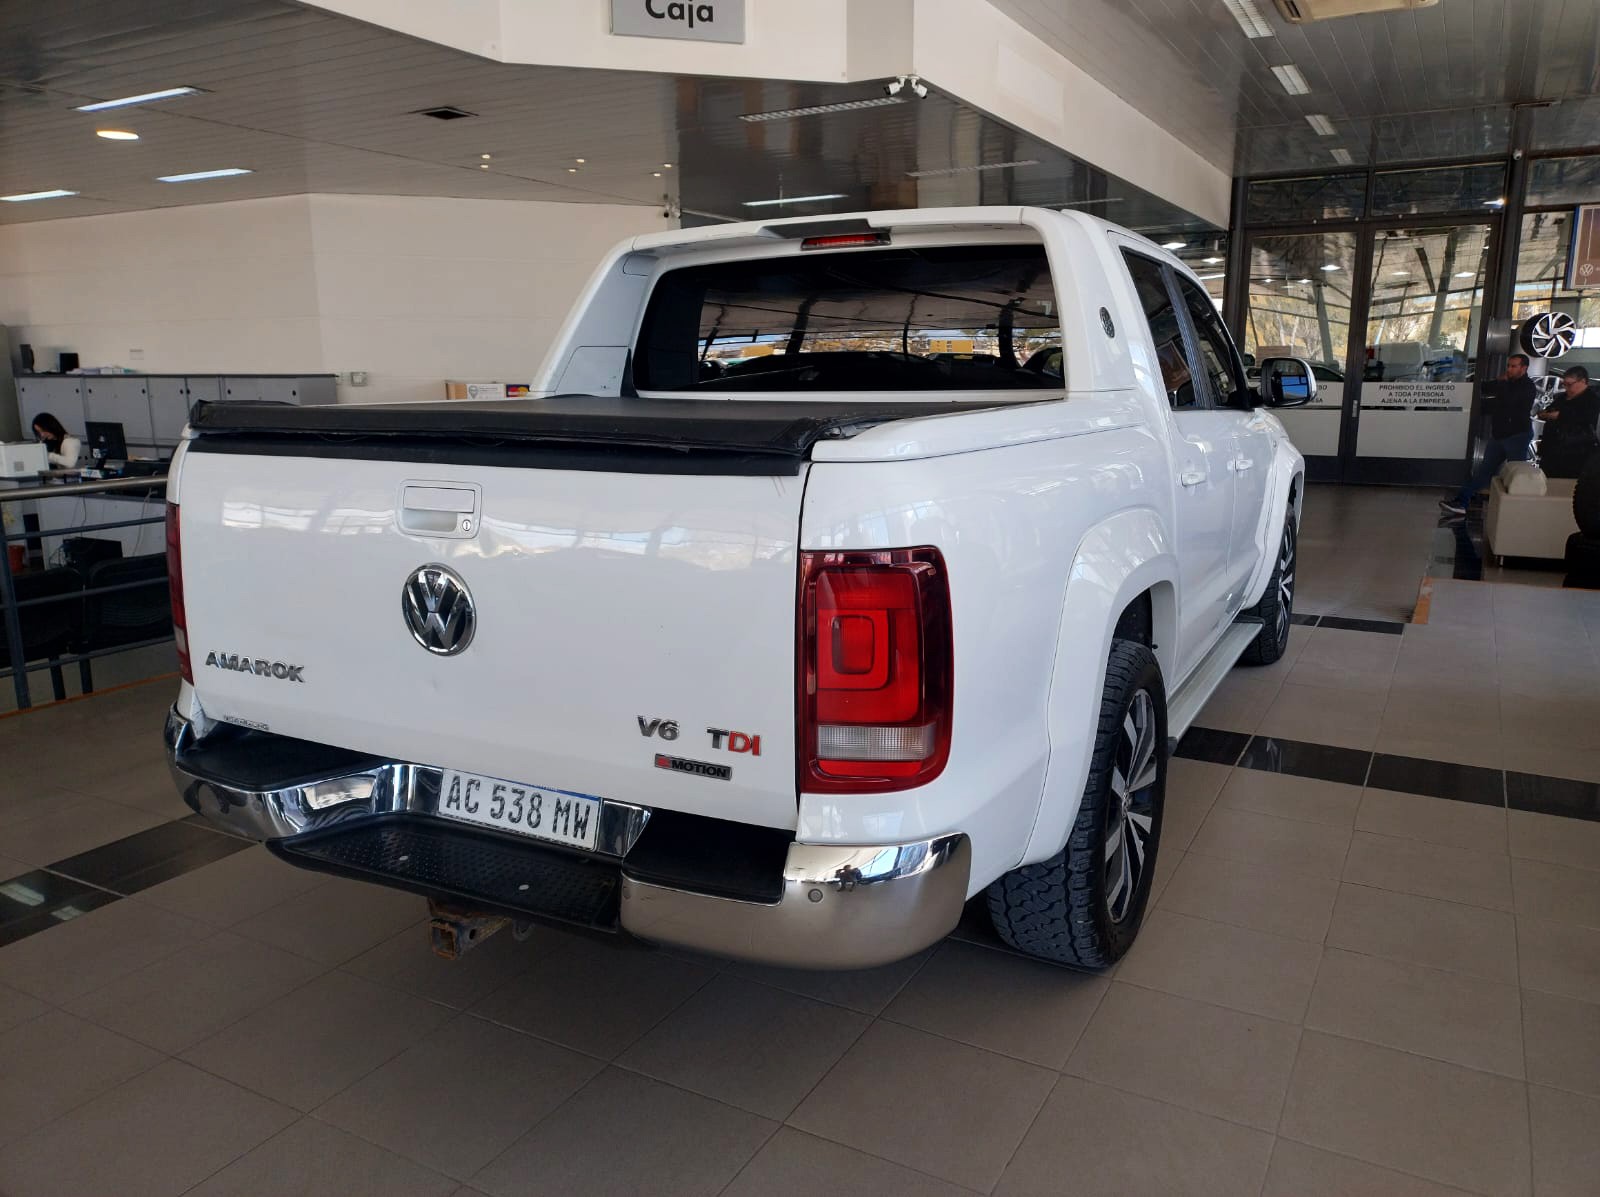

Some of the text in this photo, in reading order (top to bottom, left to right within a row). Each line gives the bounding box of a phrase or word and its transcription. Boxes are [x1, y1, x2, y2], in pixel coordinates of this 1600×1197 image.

[645, 0, 714, 28] Caja
[205, 650, 305, 683] AMAROK
[637, 715, 761, 757] V6 TDI
[446, 775, 590, 841] AC 538 MW
